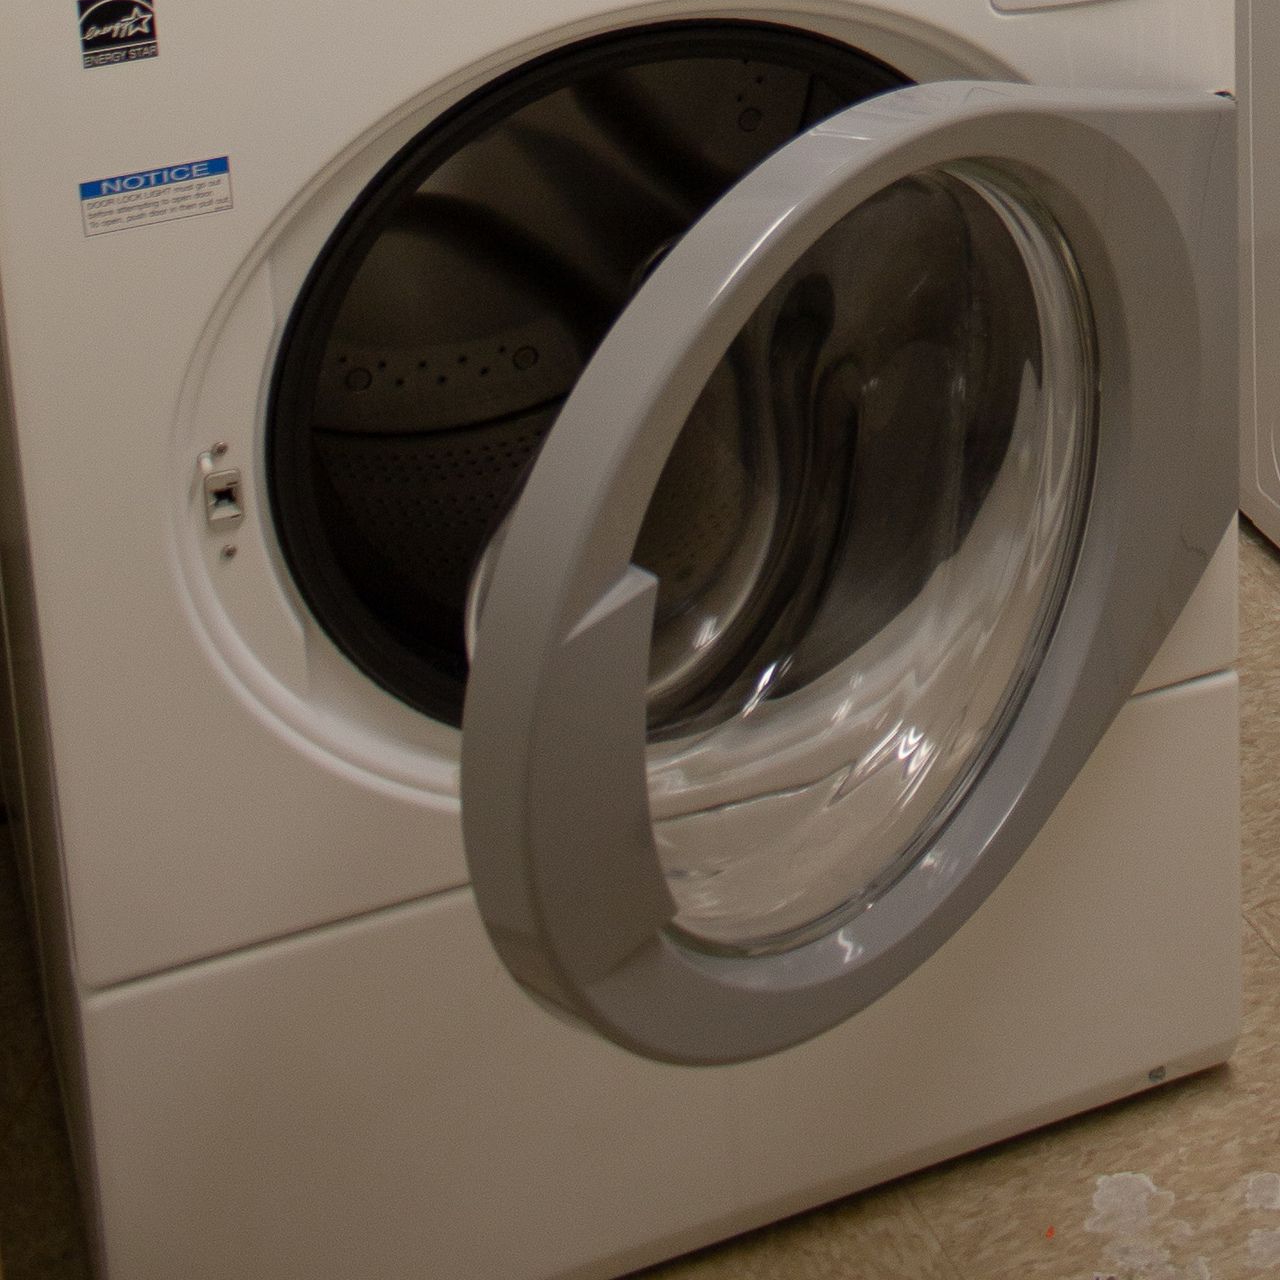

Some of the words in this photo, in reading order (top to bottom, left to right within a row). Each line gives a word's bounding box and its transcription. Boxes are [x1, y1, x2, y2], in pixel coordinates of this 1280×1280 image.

[84, 48, 127, 67] ENERGY
[101, 163, 209, 195] NOTICE
[116, 194, 142, 204] LOCK
